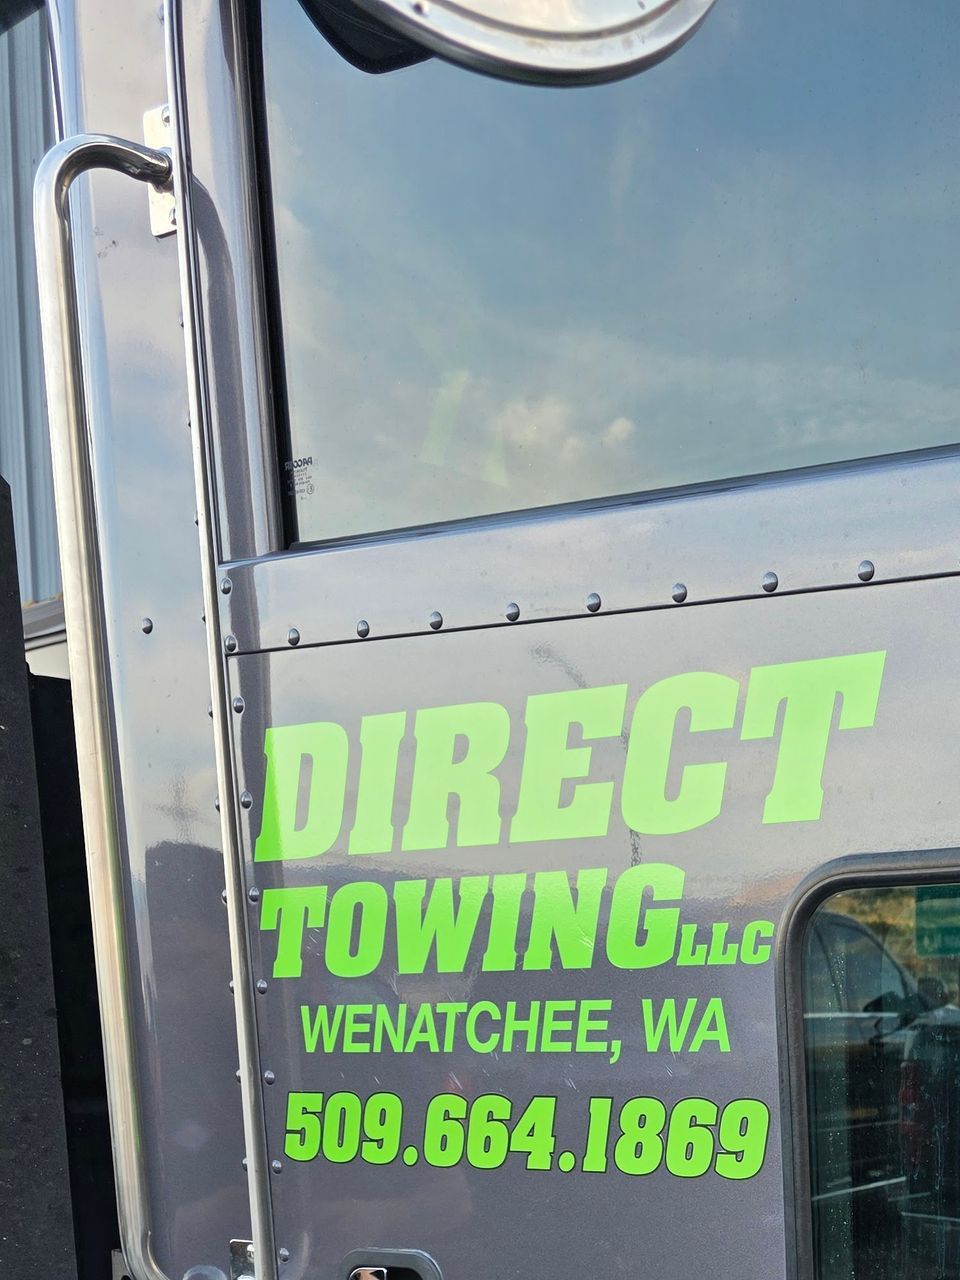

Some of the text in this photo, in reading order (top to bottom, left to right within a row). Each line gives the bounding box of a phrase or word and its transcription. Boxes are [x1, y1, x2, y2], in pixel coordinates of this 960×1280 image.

[254, 650, 887, 862] DIRECT
[260, 862, 774, 978] TOWING LLC
[300, 997, 730, 1064] WENATCHEE, WA
[283, 1091, 770, 1181] 509.664.1869
